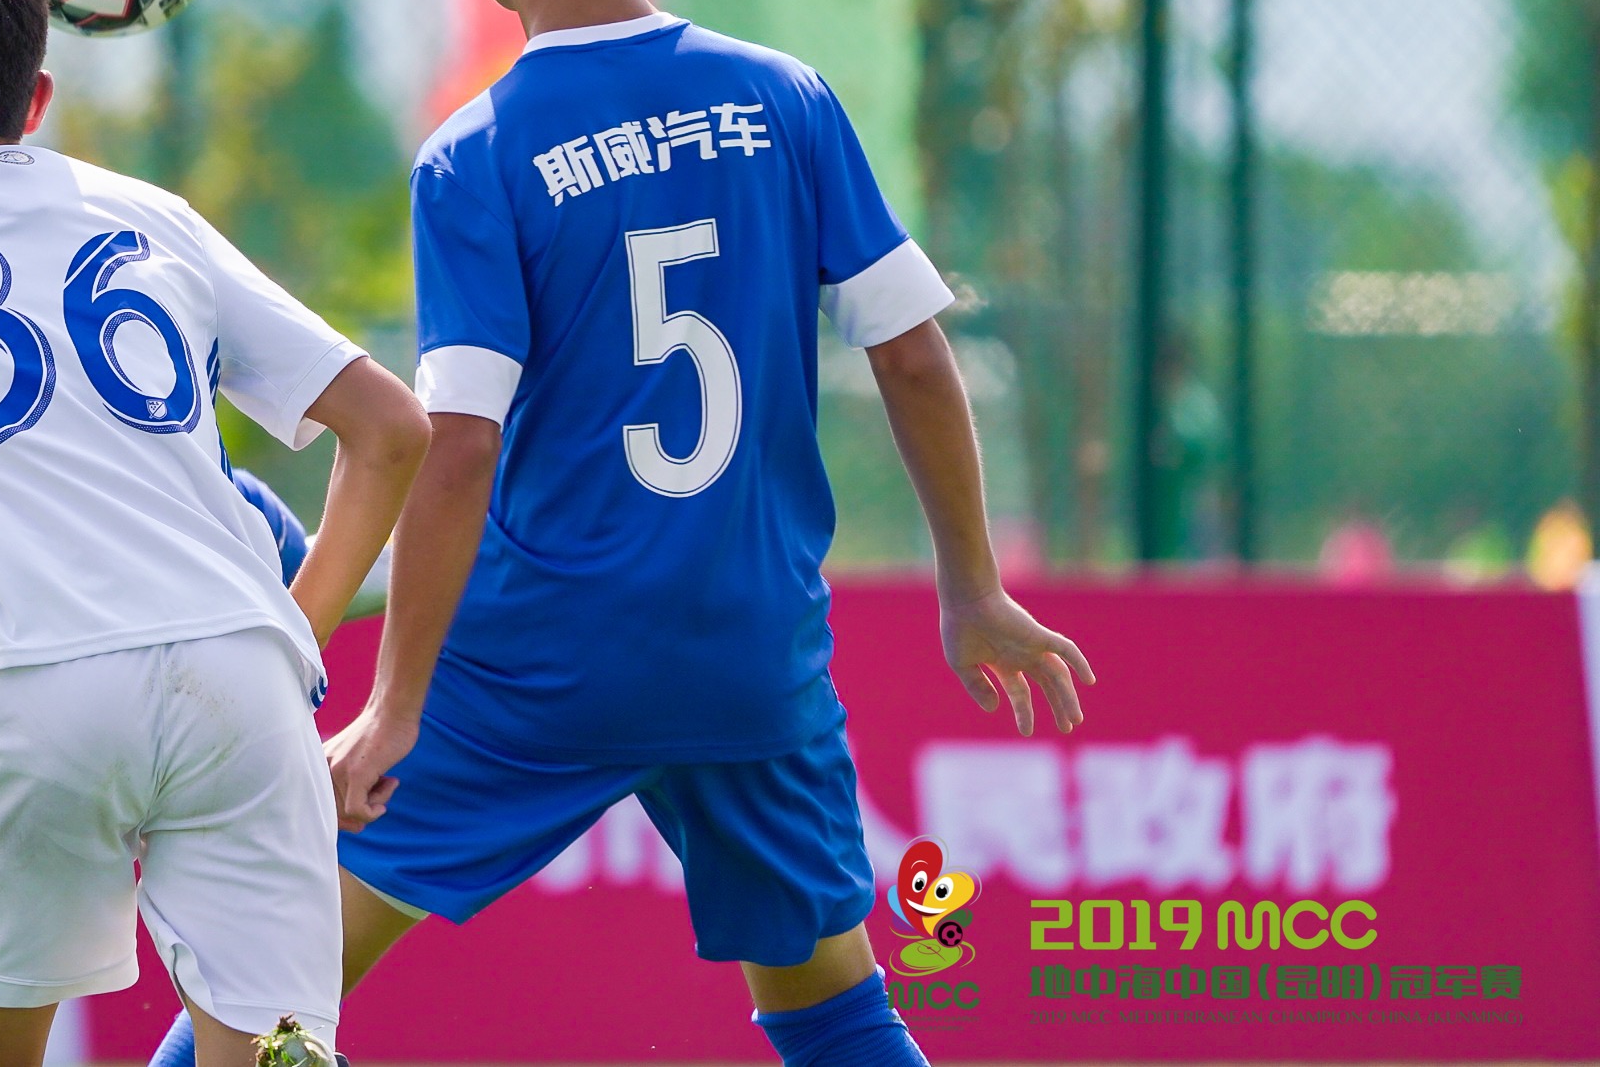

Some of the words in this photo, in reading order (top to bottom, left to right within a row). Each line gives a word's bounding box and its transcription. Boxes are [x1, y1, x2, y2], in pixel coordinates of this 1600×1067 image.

[533, 102, 771, 207] 斯威汽车
[623, 217, 743, 499] 5
[858, 738, 1394, 891] 民政府
